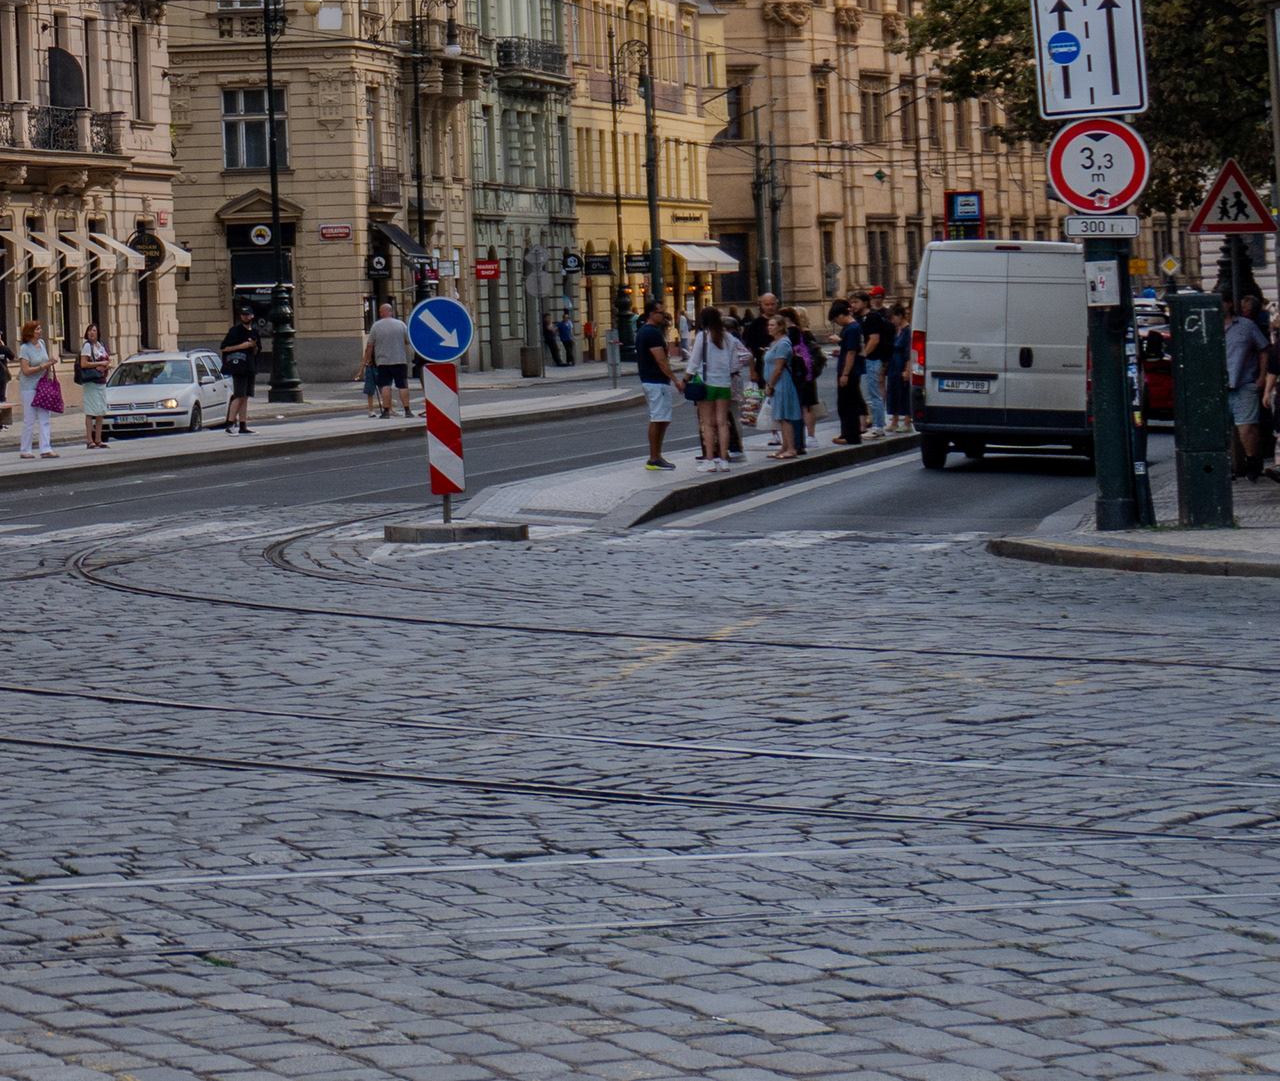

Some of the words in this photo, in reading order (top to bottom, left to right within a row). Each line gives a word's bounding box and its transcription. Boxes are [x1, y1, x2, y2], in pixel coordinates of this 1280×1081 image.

[1080, 146, 1114, 170] 3,3
[1092, 172, 1105, 182] m
[1080, 220, 1105, 233] 300
